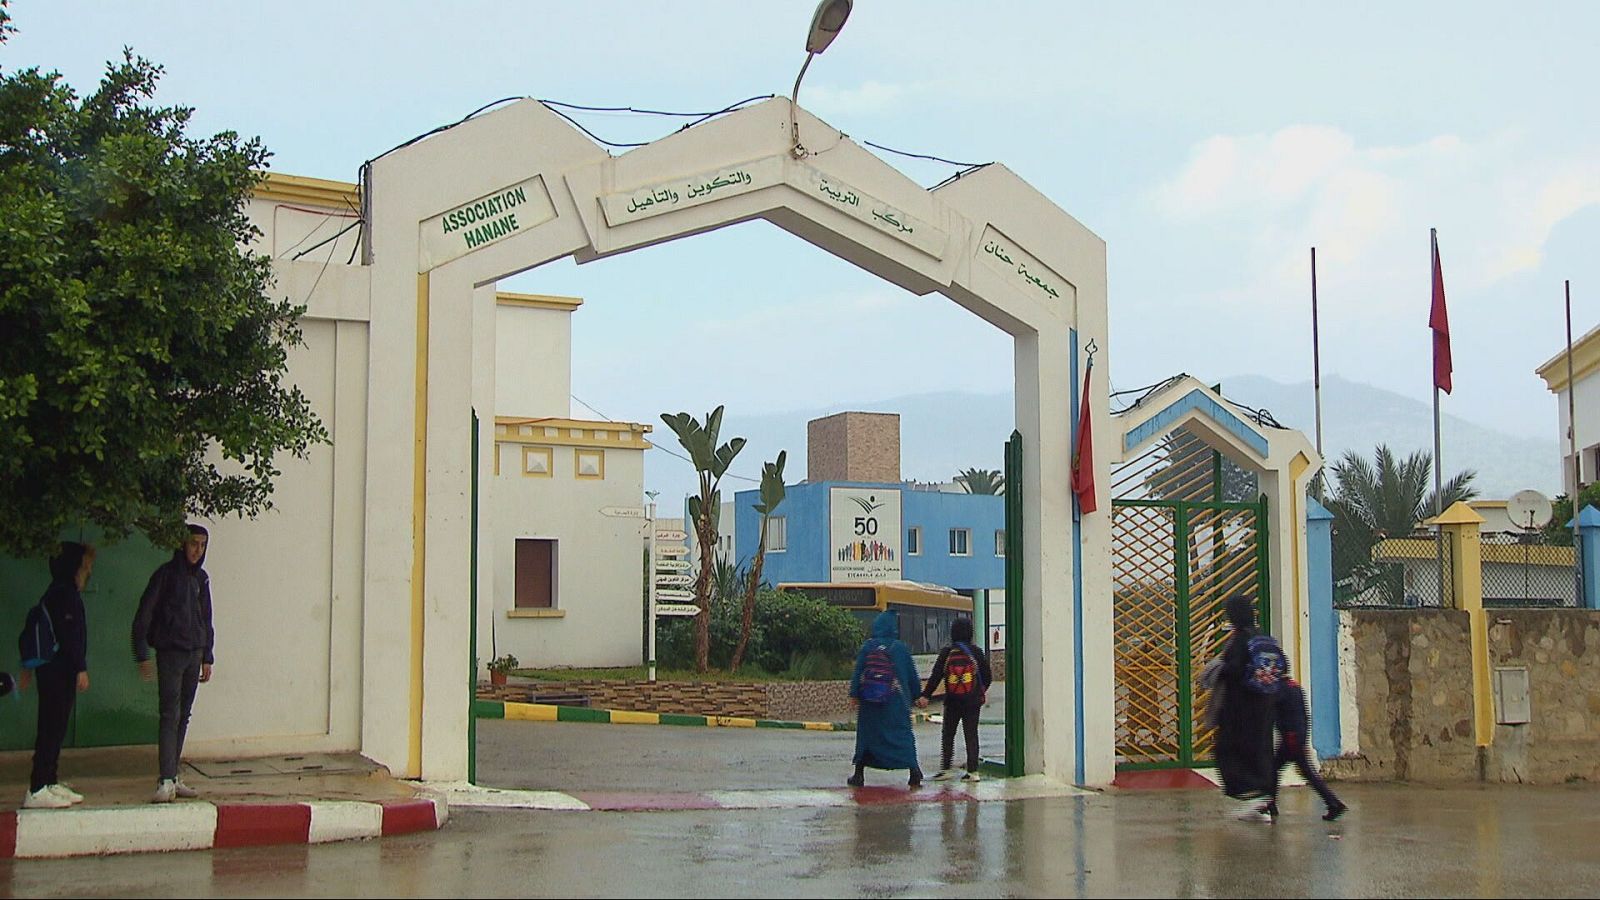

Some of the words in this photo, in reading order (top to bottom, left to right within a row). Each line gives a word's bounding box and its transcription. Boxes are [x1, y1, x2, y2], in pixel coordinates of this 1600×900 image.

[687, 170, 752, 198] والتكوين
[819, 179, 860, 207] التربية
[442, 186, 527, 234] ASSOCIATION
[627, 189, 679, 212] والتأهيل
[463, 213, 519, 249] HANANE
[870, 208, 913, 234] مركب
[984, 241, 1013, 265] حنان
[1018, 263, 1059, 299] جمعية
[854, 517, 878, 535] 50
